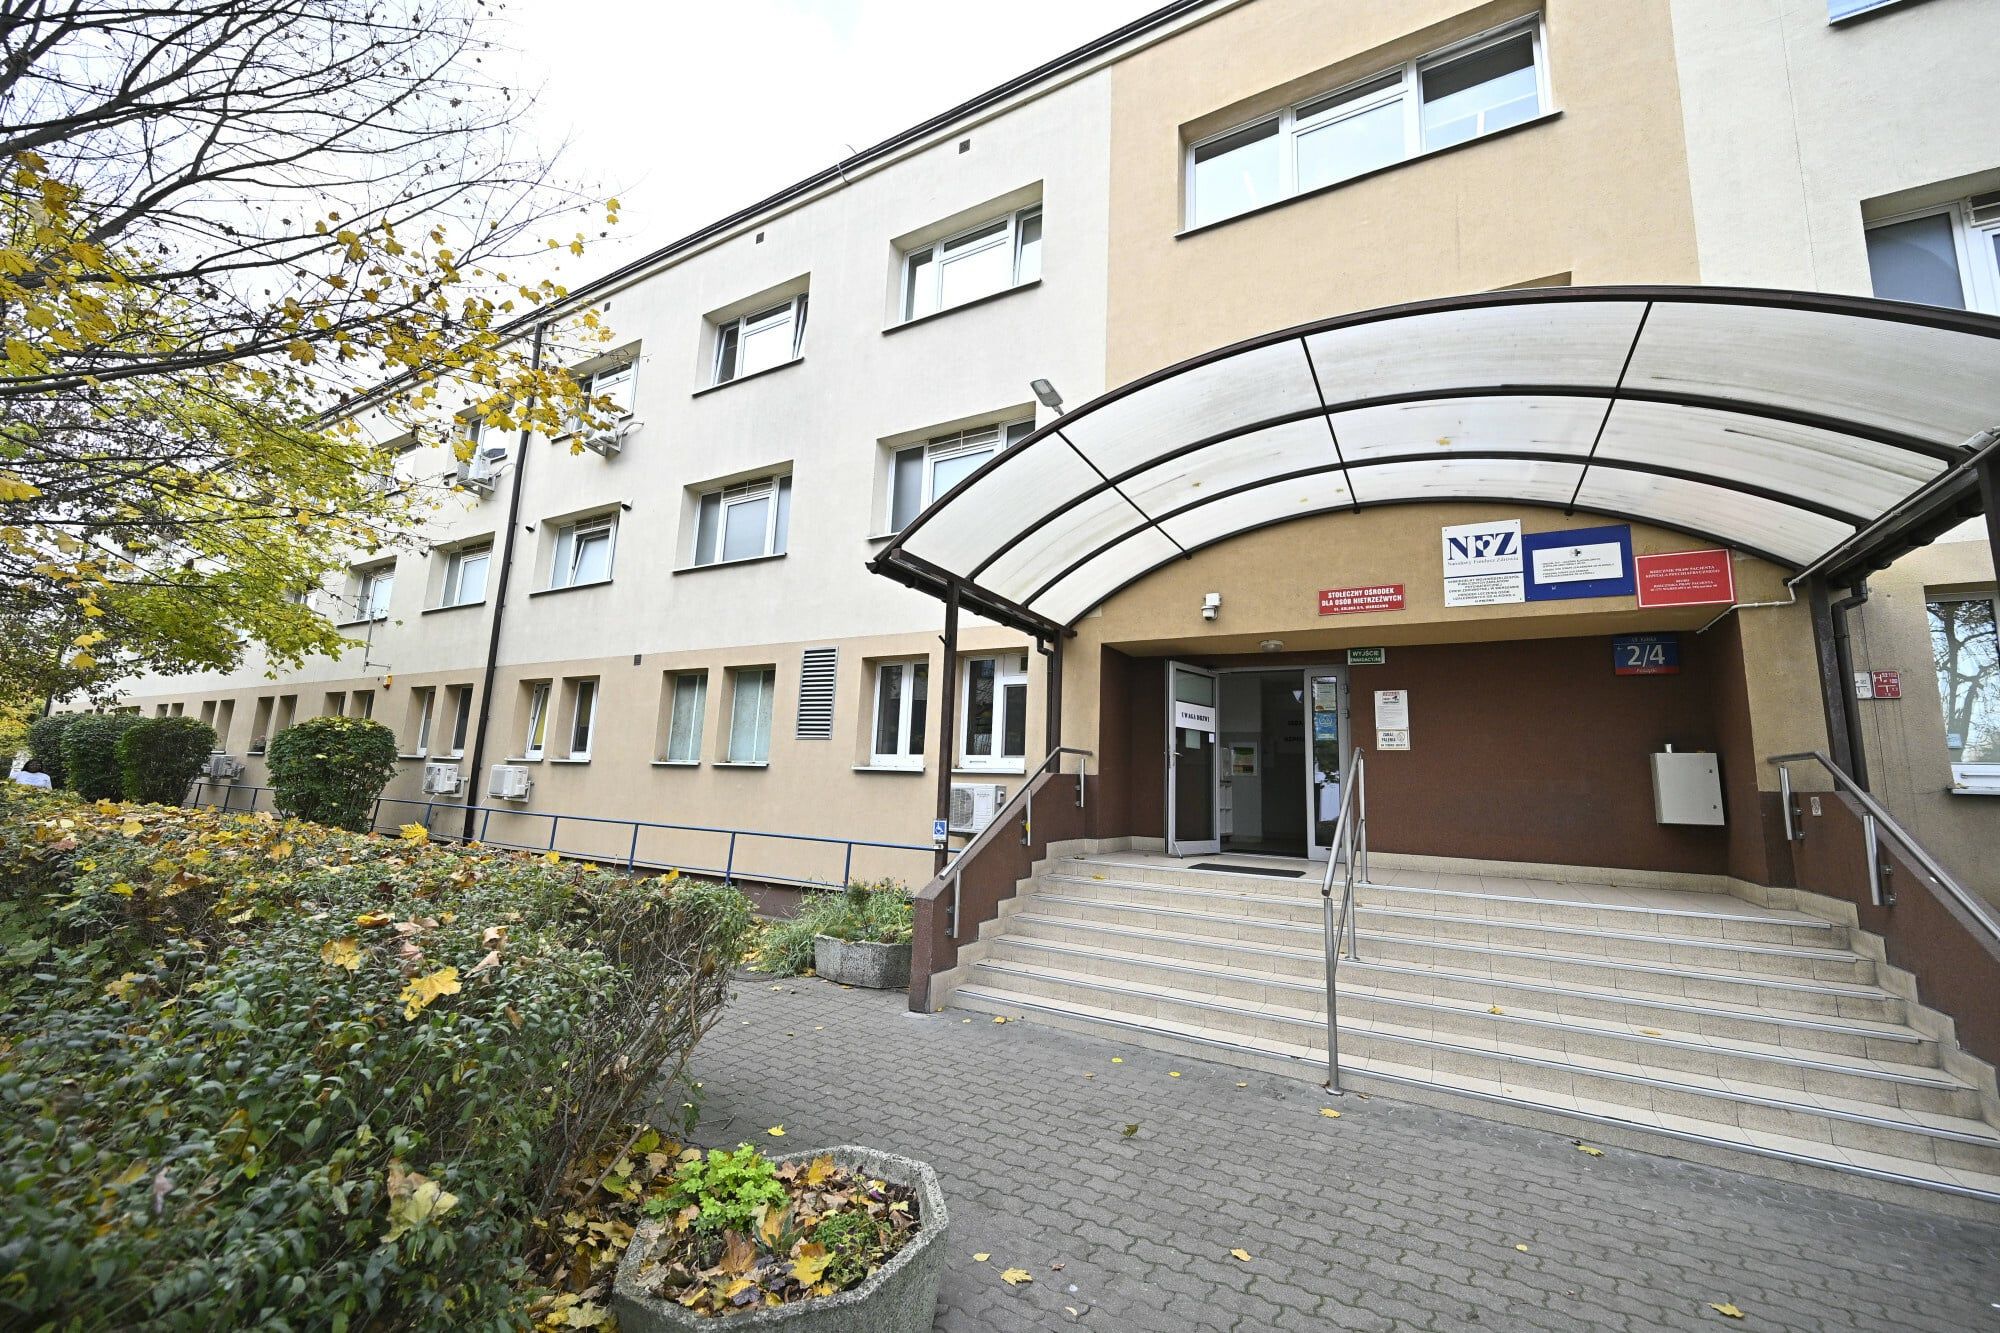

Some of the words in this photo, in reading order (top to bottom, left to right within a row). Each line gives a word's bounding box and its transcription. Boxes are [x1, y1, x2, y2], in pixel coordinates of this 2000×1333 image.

[1446, 532, 1517, 560] NFZ
[1328, 590, 1363, 598] STOŁECZNY
[1364, 588, 1394, 596] OŚRODEK
[1353, 595, 1402, 604] NIETRZEŹWYCH
[1627, 645, 1665, 667] 2/4
